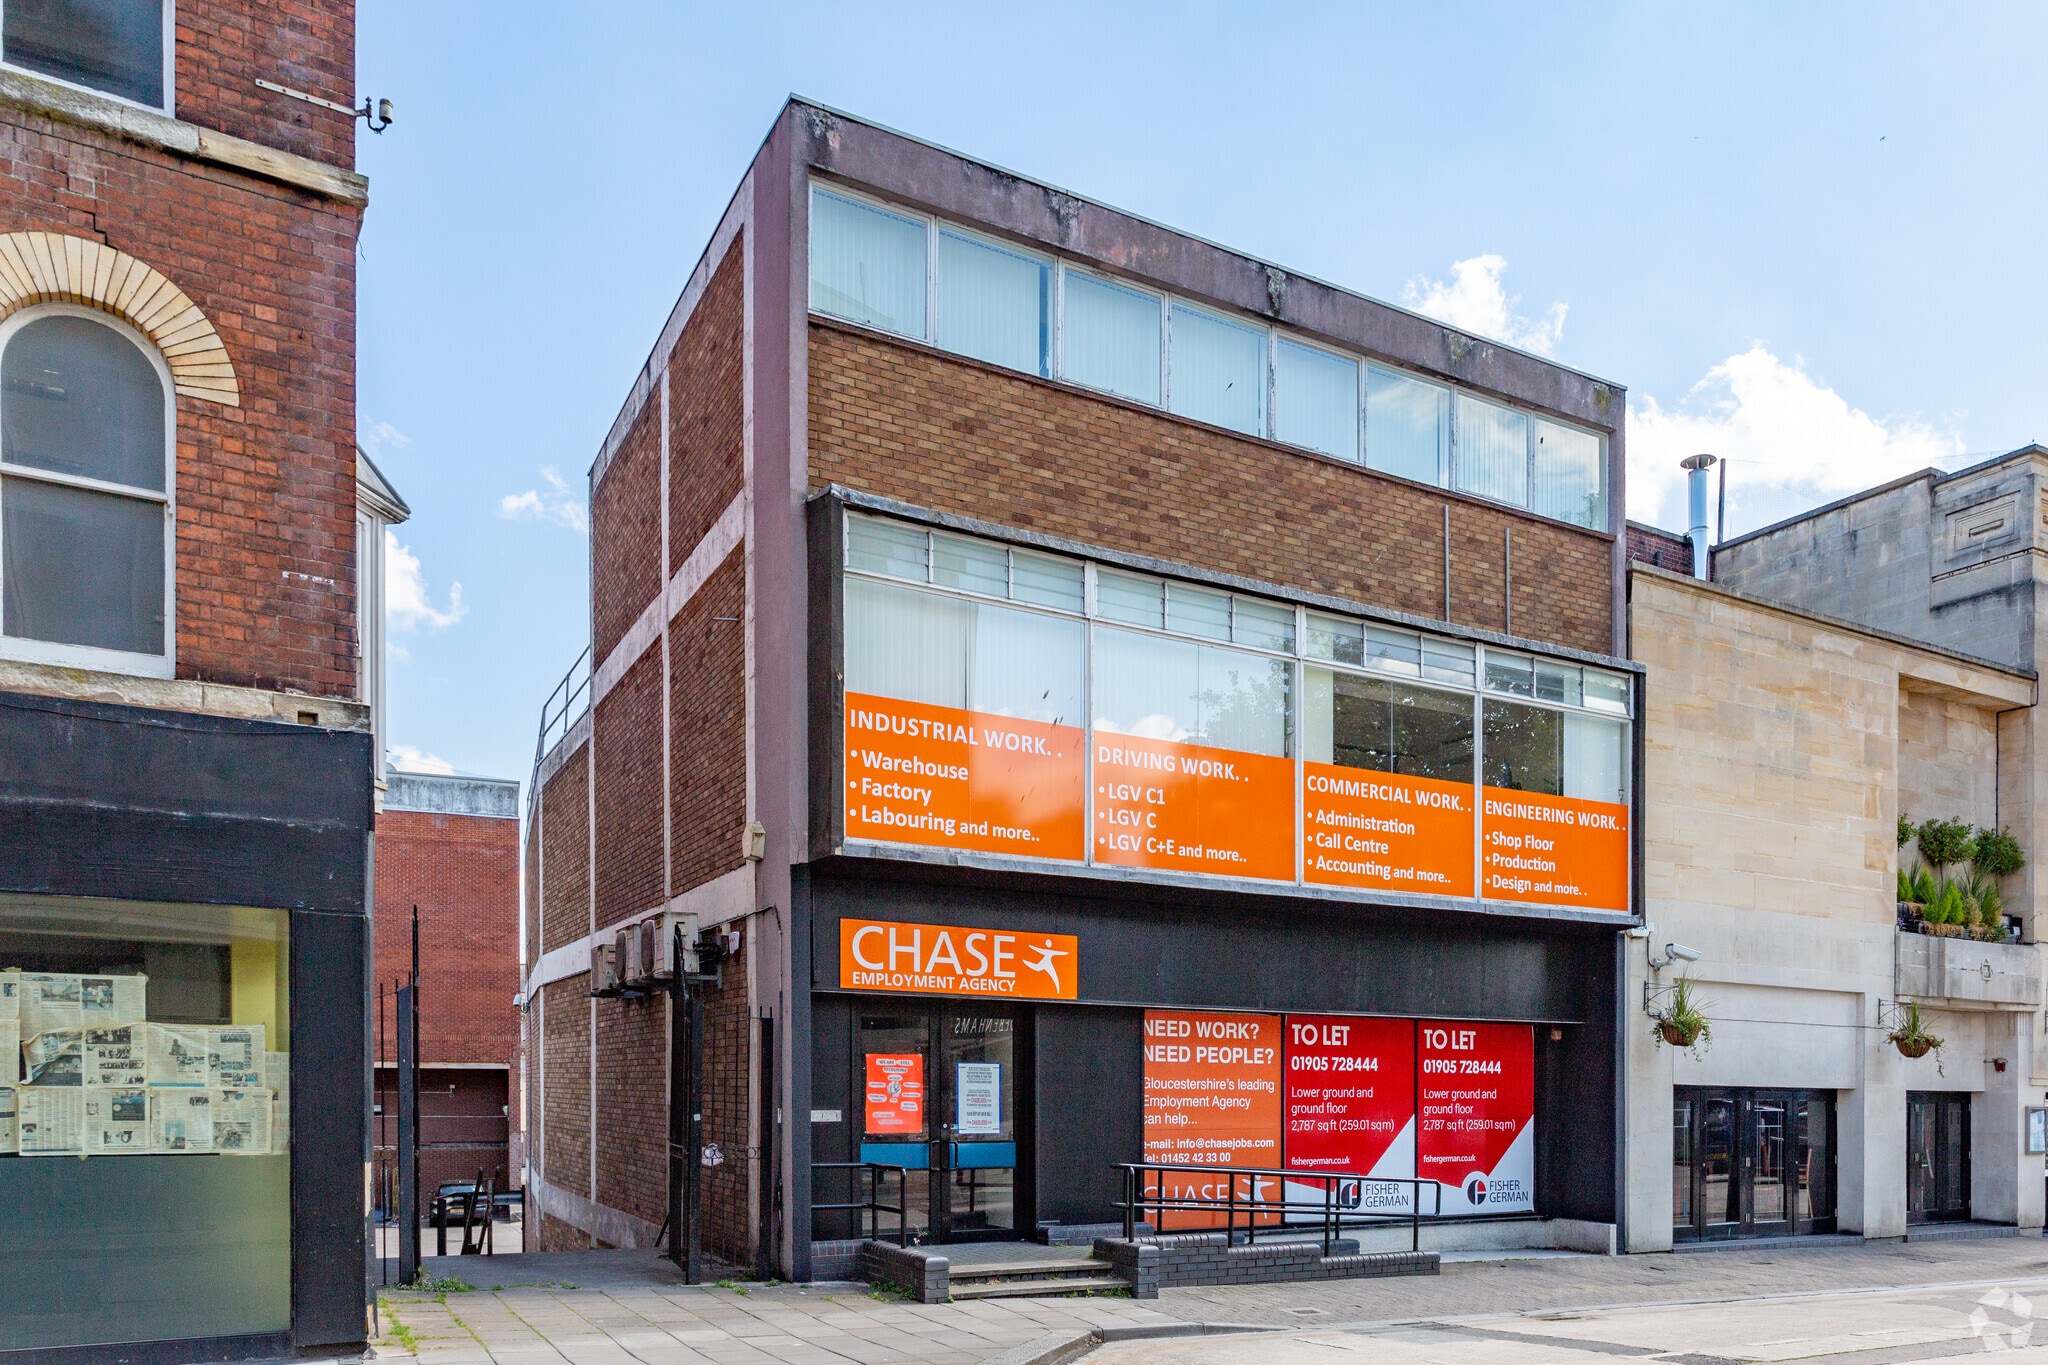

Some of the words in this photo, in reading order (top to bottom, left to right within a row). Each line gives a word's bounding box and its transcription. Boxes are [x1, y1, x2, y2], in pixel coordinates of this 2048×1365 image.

[850, 709, 978, 745] INDUSTRIAL
[862, 749, 968, 781] Warehouse
[1098, 746, 1175, 772] DRIVING
[862, 777, 932, 806] Factory
[1108, 783, 1141, 801] LGV
[1146, 787, 1165, 805] C1
[1307, 775, 1411, 804] COMMERCIAL
[862, 805, 955, 836] Labouring
[960, 821, 988, 836] and
[1108, 808, 1141, 827] LGV
[1146, 812, 1157, 829] C
[1485, 800, 1574, 824] ENGINEERING
[1316, 809, 1415, 835] Administration
[1109, 833, 1141, 852] LGV
[1146, 837, 1175, 855] C+E
[1178, 844, 1202, 858] and
[1316, 832, 1340, 849] Call
[1344, 836, 1389, 854] Centre
[1492, 831, 1522, 850] Shop
[1525, 835, 1555, 851] Floor
[1316, 856, 1391, 880] Accounting
[1393, 867, 1414, 880] and
[1492, 853, 1556, 872] Production
[1492, 874, 1532, 893] Design
[1534, 881, 1551, 893] and
[852, 925, 1016, 978] CHASE
[852, 971, 955, 989] EMPLOYMENT
[959, 978, 1016, 992] AGENCY
[1144, 1019, 1191, 1037] NEED
[1196, 1021, 1260, 1039] WORK?
[1292, 1024, 1318, 1045] TO
[1323, 1025, 1350, 1046] LET
[1424, 1029, 1448, 1050] TO
[1451, 1030, 1476, 1050] LET
[1144, 1045, 1191, 1063] NEED
[1196, 1047, 1274, 1065] PEOPLE?
[1291, 1056, 1328, 1071] 01905
[1331, 1057, 1378, 1072] 728444
[1423, 1059, 1457, 1074] 01905
[1460, 1060, 1501, 1074] 728444
[1238, 1078, 1275, 1093] leading
[1292, 1087, 1319, 1098] Lower
[1322, 1087, 1355, 1101] ground
[1356, 1087, 1373, 1098] and
[1423, 1088, 1449, 1099] Lower
[1451, 1088, 1480, 1101] ground
[1481, 1088, 1497, 1099] and
[1211, 1095, 1251, 1110] Agency
[1292, 1102, 1324, 1116] ground
[1326, 1102, 1347, 1113] floor
[1423, 1103, 1453, 1116] ground
[1455, 1103, 1474, 1114] floor
[1165, 1113, 1198, 1128] help...
[1292, 1120, 1315, 1132] 2,787
[1317, 1122, 1329, 1132] sq
[1330, 1119, 1337, 1130] ft
[1339, 1120, 1369, 1132] (259.01
[1423, 1120, 1444, 1132] 2,787
[1446, 1122, 1457, 1132] sq
[1458, 1119, 1465, 1130] ft
[1466, 1119, 1493, 1132] (259.01
[1177, 1138, 1275, 1150] info@chasejobs.com
[1161, 1153, 1190, 1163] 01452
[1192, 1153, 1203, 1163] 42
[1206, 1153, 1217, 1163] 33
[1219, 1152, 1231, 1163] 00
[1292, 1156, 1350, 1167] fishergerman.co.uk
[1423, 1154, 1476, 1164] fishergerman.co.uk
[1365, 1183, 1400, 1195] FISHER
[1490, 1180, 1520, 1191] FISHER
[1365, 1195, 1409, 1208] GERMAN
[1489, 1191, 1529, 1203] GERMAN
